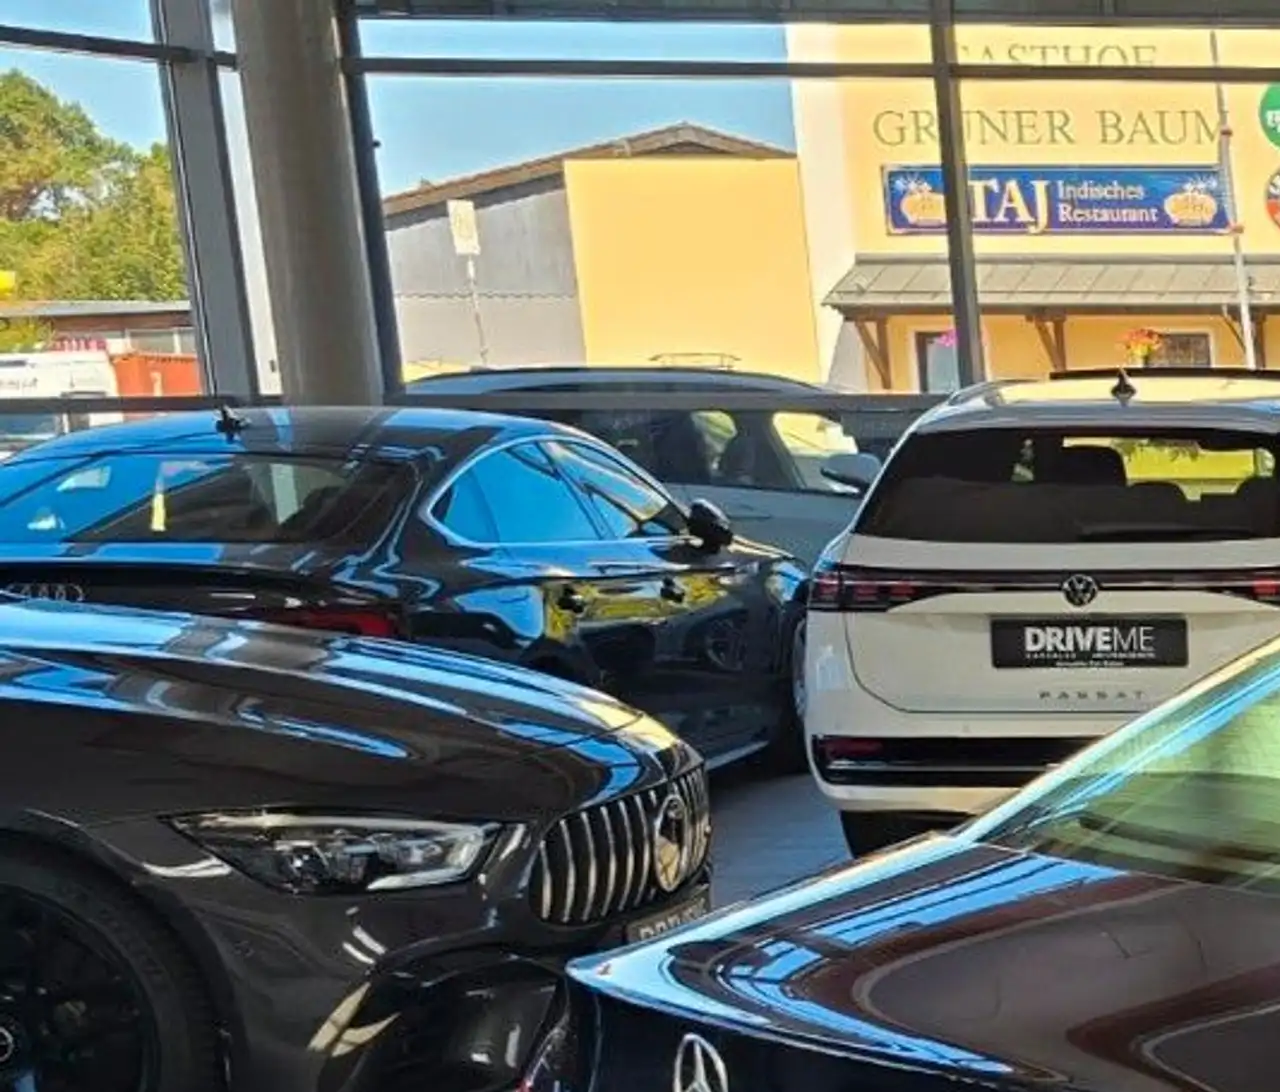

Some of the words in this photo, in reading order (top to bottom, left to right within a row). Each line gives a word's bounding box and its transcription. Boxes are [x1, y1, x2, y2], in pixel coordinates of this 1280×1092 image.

[1057, 179, 1145, 201] Indisches
[967, 178, 1051, 235] TAJ
[1057, 203, 1159, 223] Restaurant
